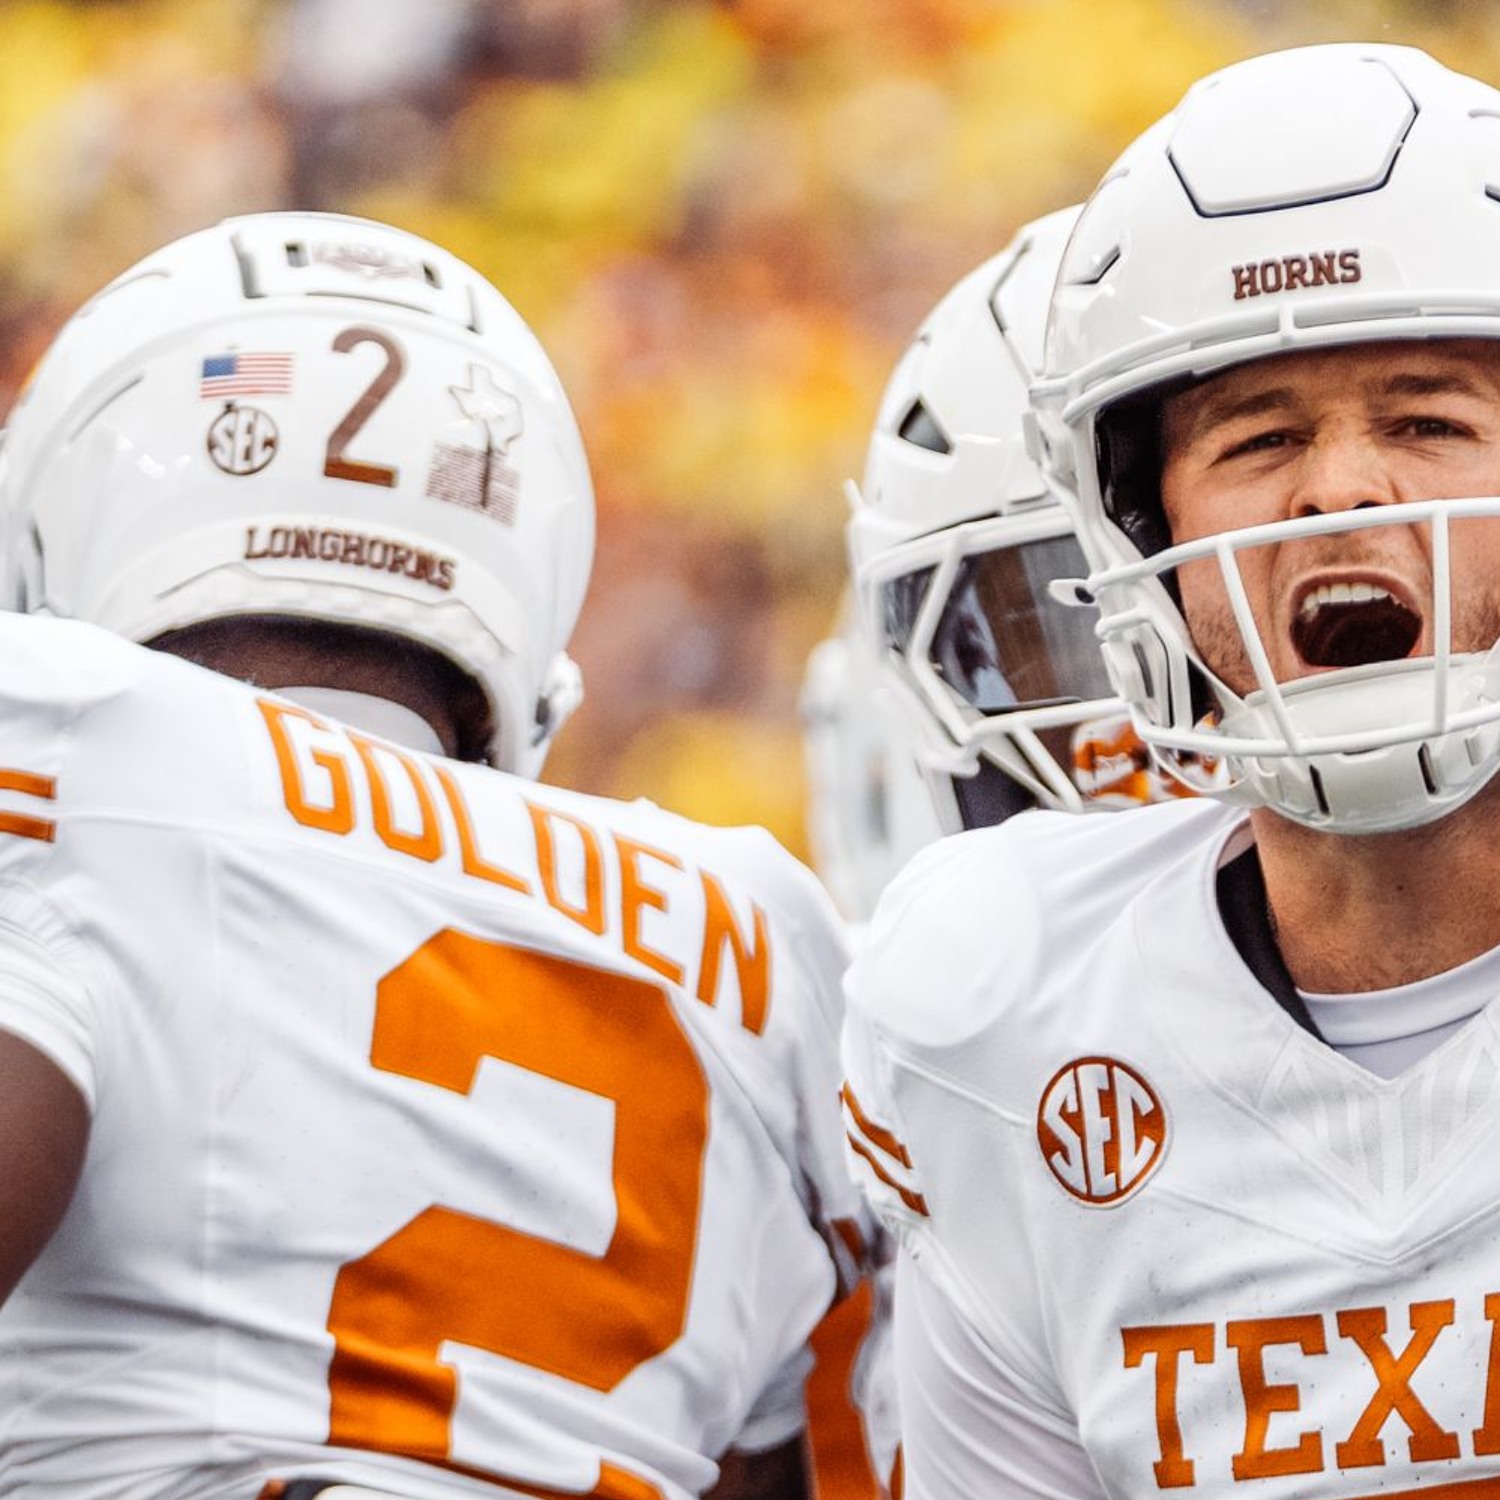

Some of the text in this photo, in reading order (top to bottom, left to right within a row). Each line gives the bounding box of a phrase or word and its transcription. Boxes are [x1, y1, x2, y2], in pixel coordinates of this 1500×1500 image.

[1231, 249, 1362, 300] HORNS
[207, 405, 279, 475] SEC
[324, 325, 408, 488] 2
[244, 525, 456, 591] LONGHORNS
[257, 699, 774, 1036] GOLDEN
[1038, 1057, 1166, 1204] SEC
